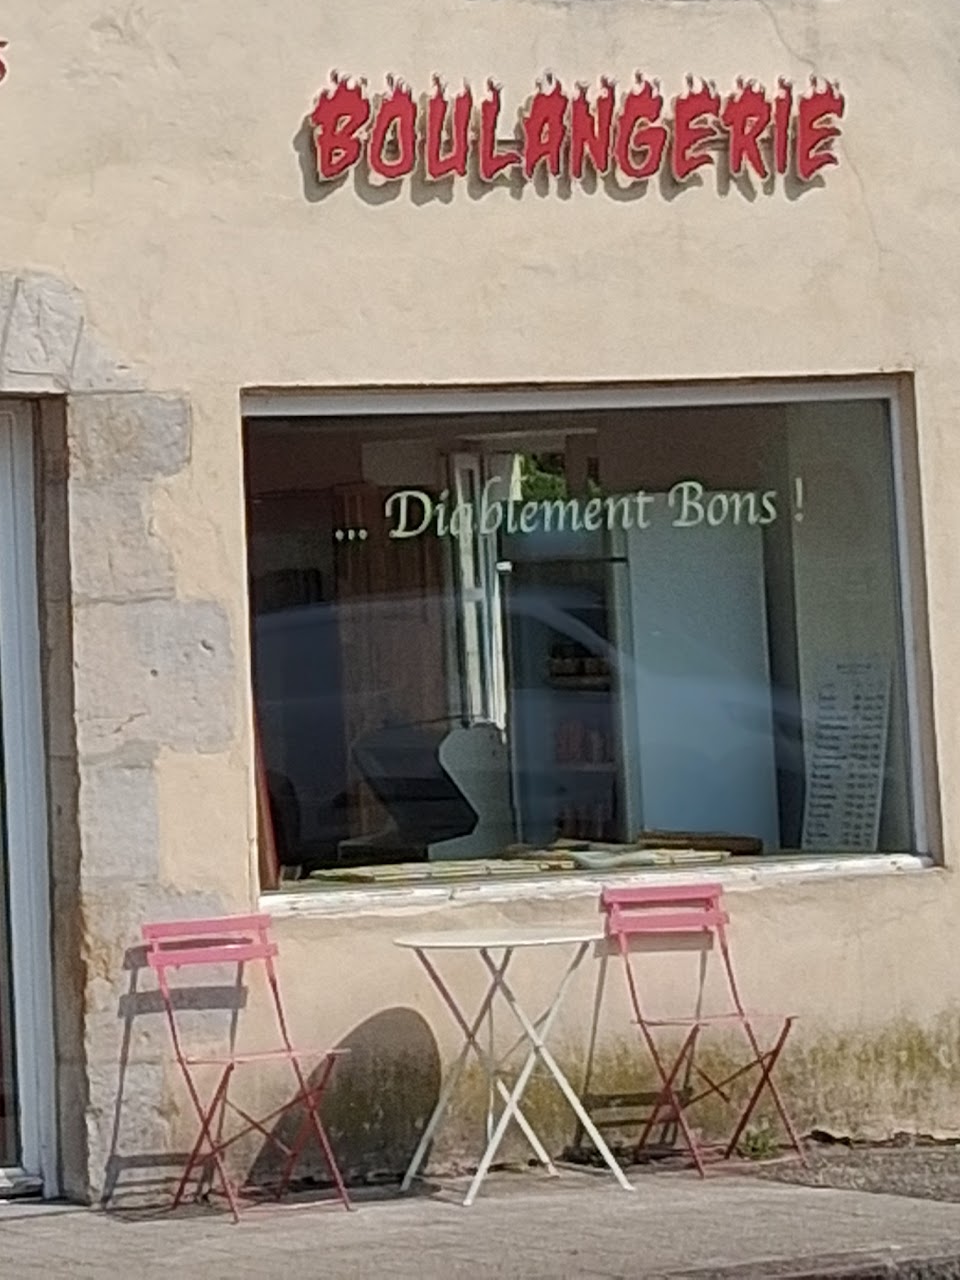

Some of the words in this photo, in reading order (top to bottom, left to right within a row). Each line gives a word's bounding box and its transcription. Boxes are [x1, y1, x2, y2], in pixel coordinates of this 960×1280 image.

[311, 68, 846, 181] BOULANGERIE
[385, 476, 655, 539] Diablement
[668, 480, 778, 528] Bons
